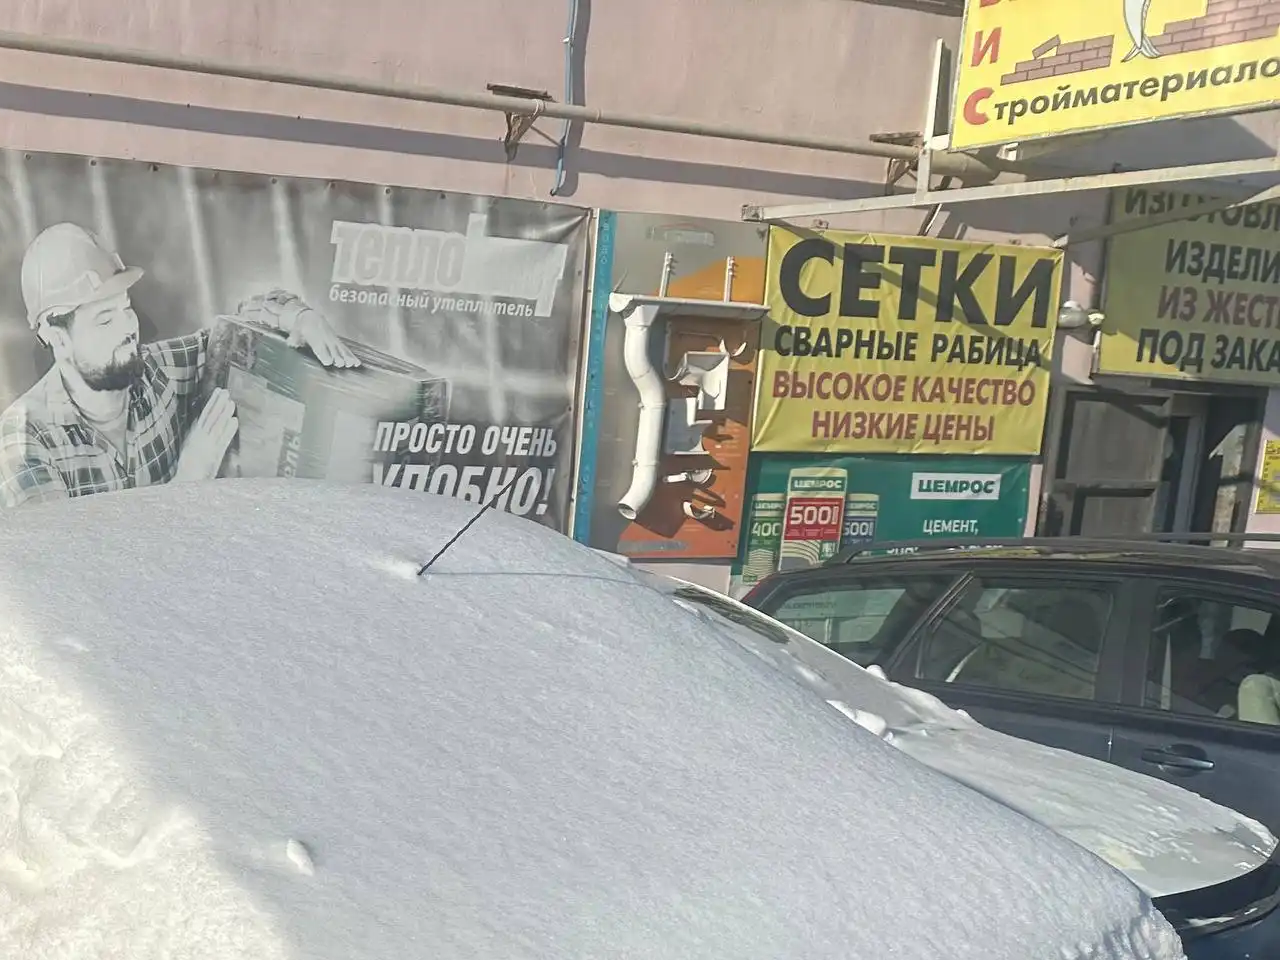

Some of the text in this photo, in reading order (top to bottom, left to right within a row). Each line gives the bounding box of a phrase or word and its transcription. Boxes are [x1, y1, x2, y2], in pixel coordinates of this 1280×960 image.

[779, 238, 1056, 329] СЕТКИ
[1157, 285, 1198, 321] ИЗ
[774, 324, 1042, 372] СВАРНЫЕ РАБИЦА
[1136, 328, 1206, 373] ПОД
[772, 370, 1036, 406] ВЫСОКОЕ КАЧЕСТВО
[373, 421, 558, 458] ПРОСТО ОЧЕНЬ
[812, 410, 995, 445] НИЗКИЕ ЦЕНЫ
[918, 479, 996, 494] ЦЕМРОС
[923, 519, 980, 535] ЦЕМЕНТ,
